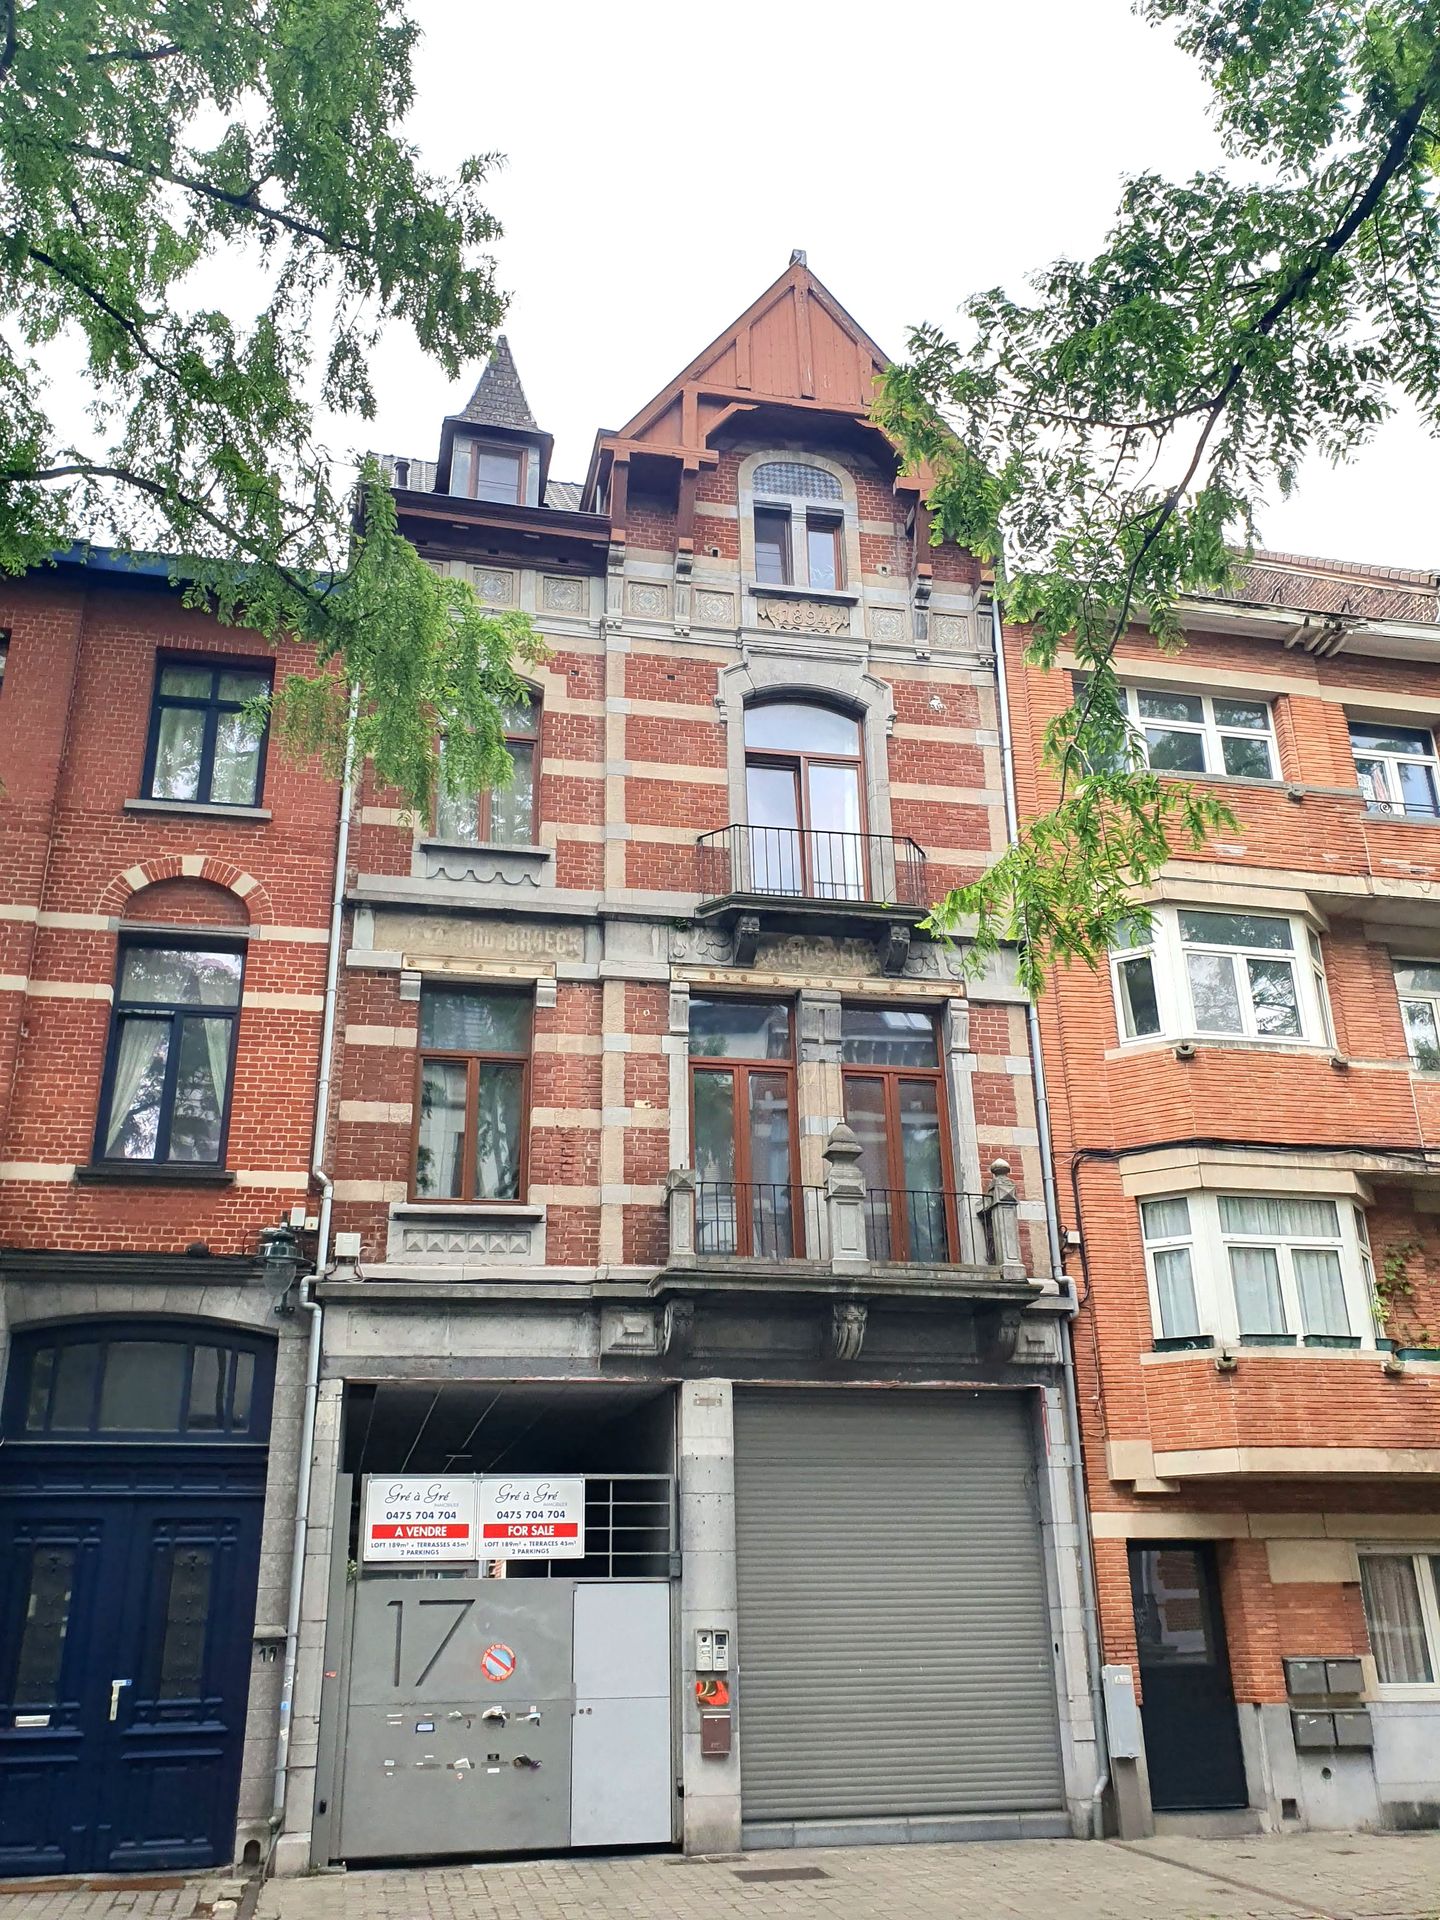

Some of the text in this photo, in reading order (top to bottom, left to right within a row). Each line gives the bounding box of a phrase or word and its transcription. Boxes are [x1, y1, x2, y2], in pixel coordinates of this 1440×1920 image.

[782, 609, 828, 626] 1894
[384, 1483, 451, 1504] Gré à Gré
[494, 1482, 559, 1504] Gré à Gré
[386, 1511, 457, 1520] 0475 704 704
[496, 1510, 566, 1519] 0475 704 704
[394, 1526, 447, 1537] A VENDRE
[507, 1525, 555, 1536] FOR SALE
[387, 1599, 475, 1687] 17
